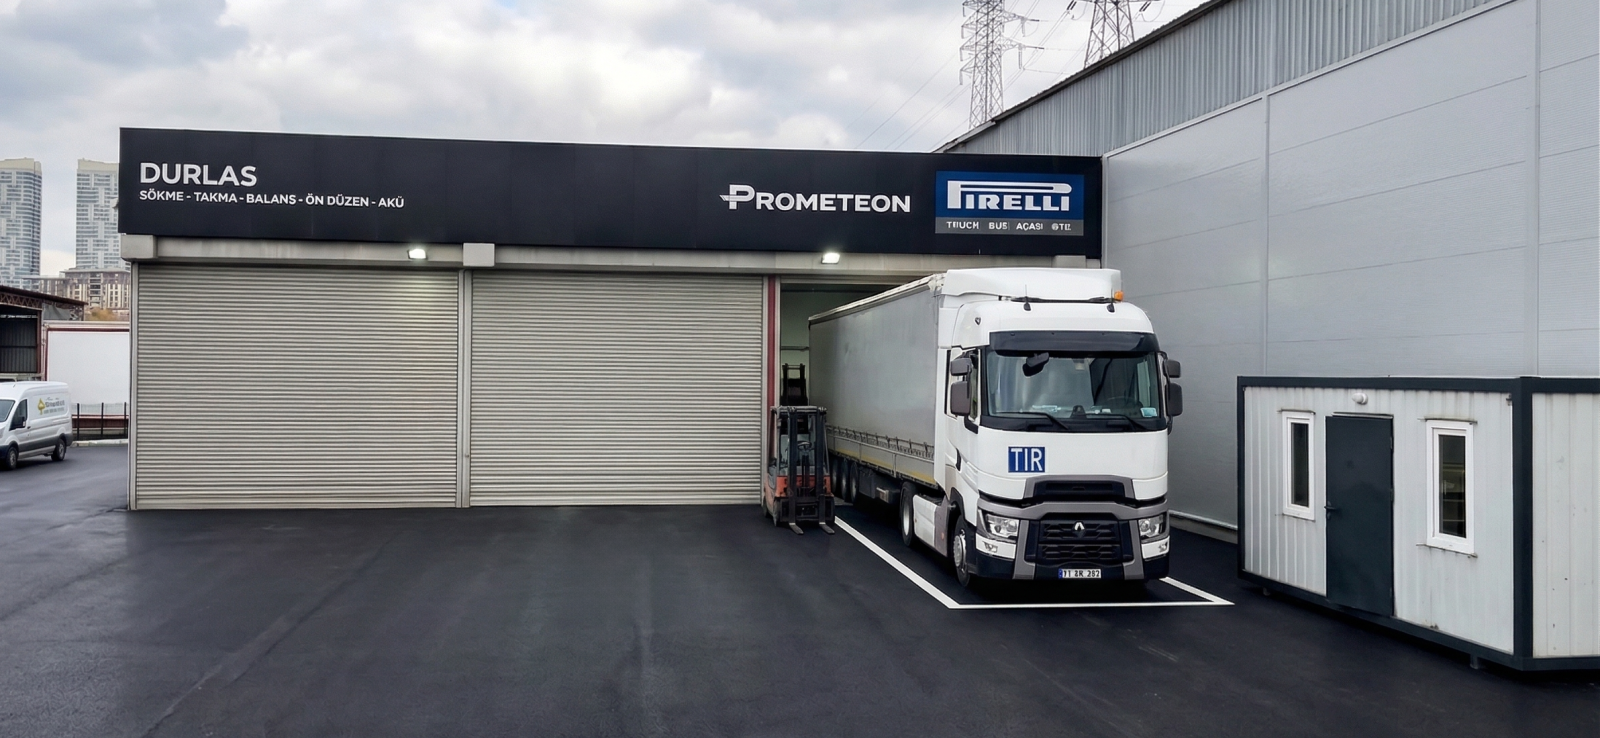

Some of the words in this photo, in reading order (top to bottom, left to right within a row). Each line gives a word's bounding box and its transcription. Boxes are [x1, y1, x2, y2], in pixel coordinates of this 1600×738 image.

[140, 162, 257, 187] DURLAS
[139, 188, 184, 201] SÖKME
[194, 191, 238, 203] TAKMA
[246, 193, 297, 205] BALANS
[305, 192, 324, 206] ÖN
[327, 193, 369, 207] DÜZEN
[378, 195, 404, 208] AKÜ
[719, 184, 911, 213] PROMETEON
[947, 180, 1072, 212] PIRELLI
[1010, 448, 1043, 472] TIR
